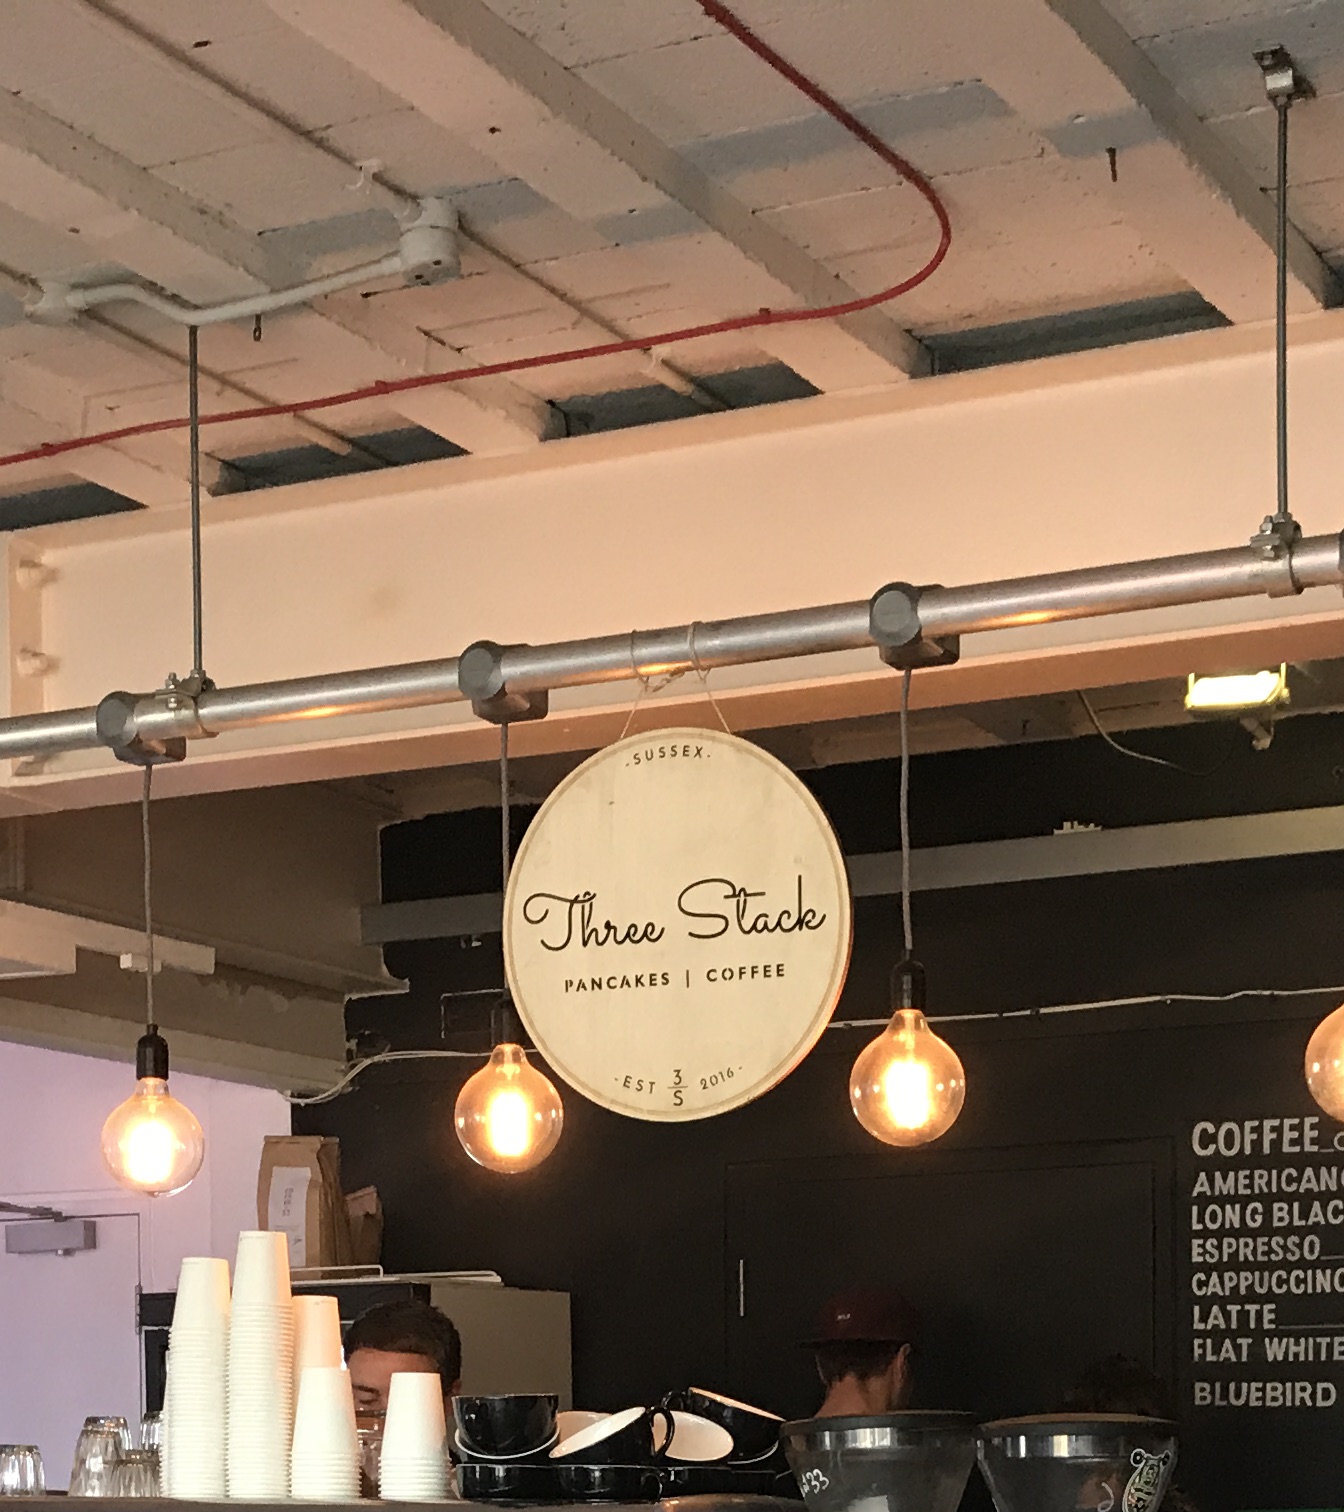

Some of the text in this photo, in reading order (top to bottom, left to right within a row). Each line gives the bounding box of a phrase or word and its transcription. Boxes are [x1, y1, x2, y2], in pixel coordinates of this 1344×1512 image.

[523, 874, 826, 951] Three Stack
[564, 971, 671, 993] PANCAKES
[706, 963, 786, 983] COFFEE
[1192, 1116, 1320, 1158] COFFEE
[1192, 1202, 1263, 1230] LONG
[1192, 1234, 1321, 1263] ESPRESSO
[1193, 1303, 1277, 1330] LATTE
[1193, 1337, 1253, 1363] FLAT
[1194, 1381, 1337, 1408] BLUEBIRD
